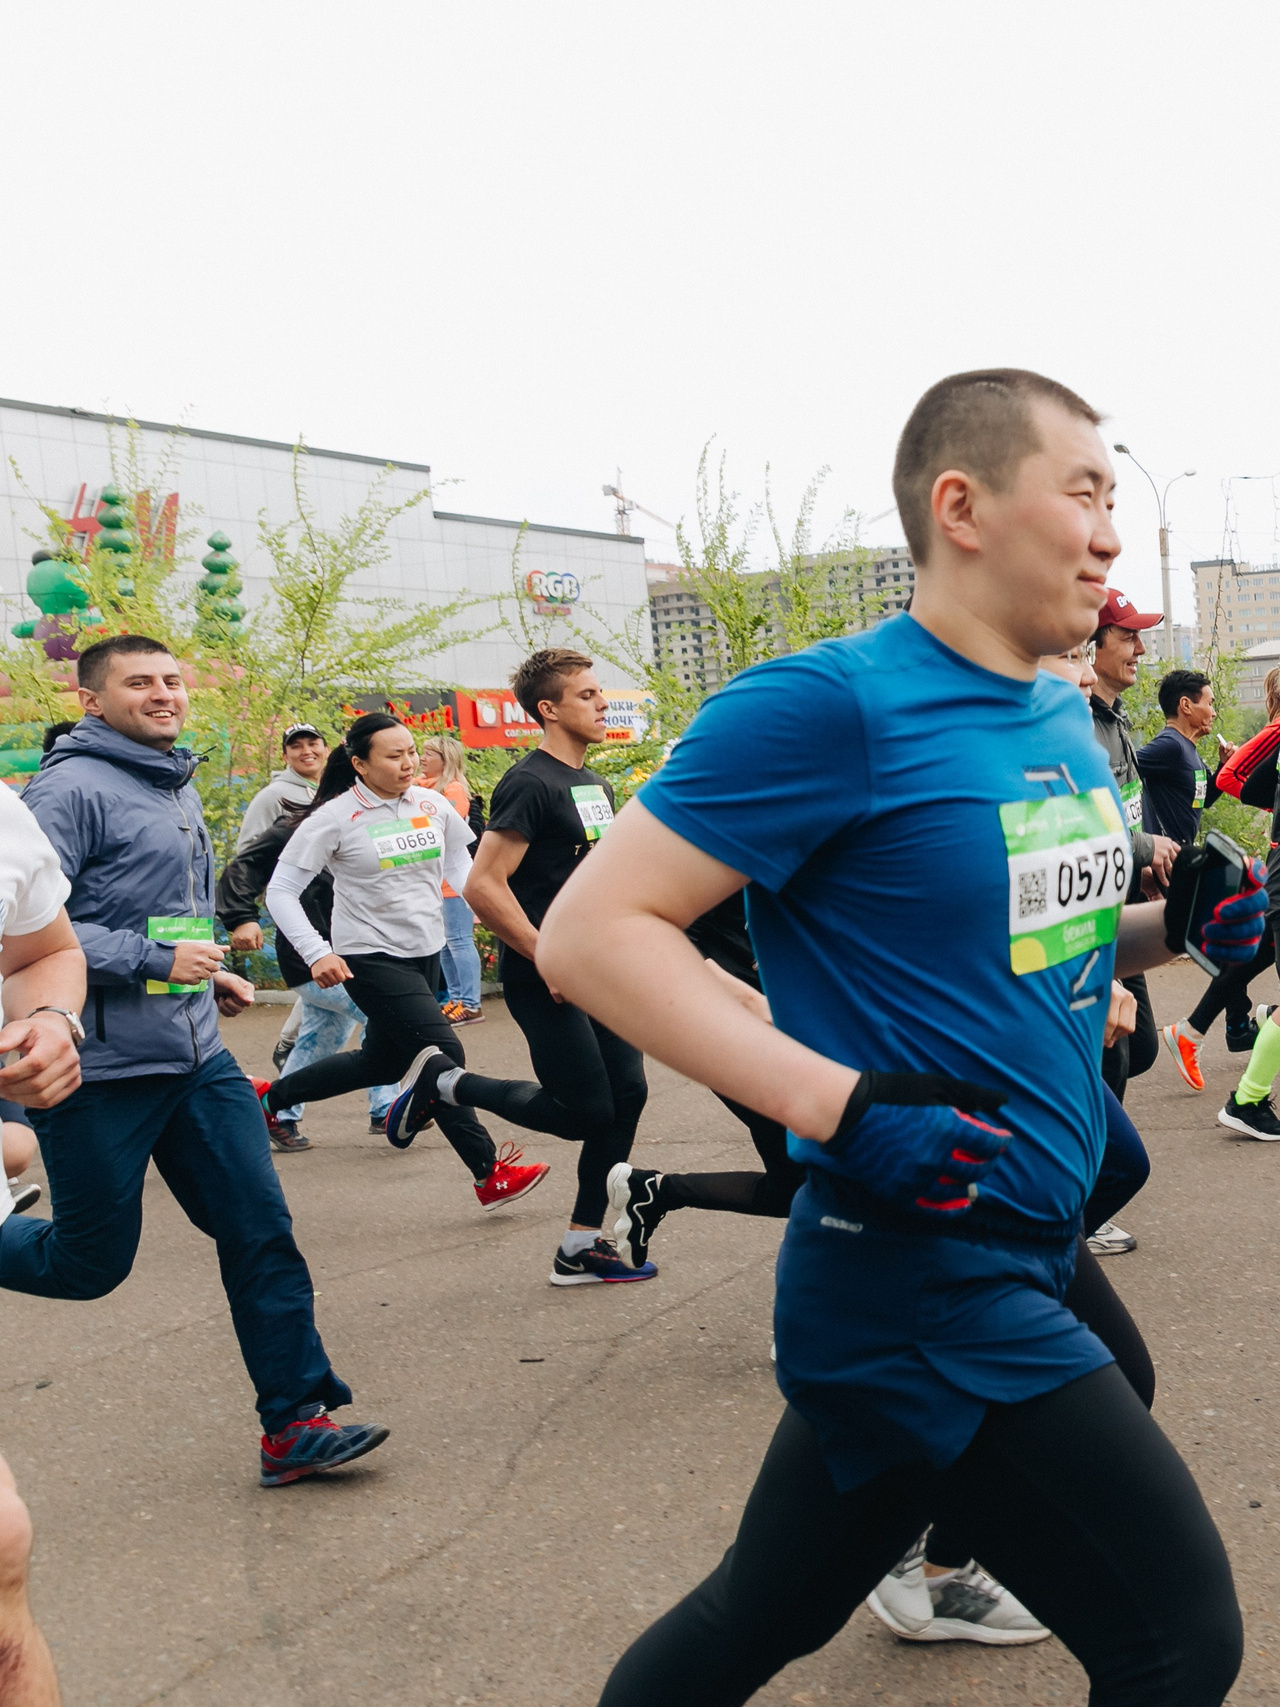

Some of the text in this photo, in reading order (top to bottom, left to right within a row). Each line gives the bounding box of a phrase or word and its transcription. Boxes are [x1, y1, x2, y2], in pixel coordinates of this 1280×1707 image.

[526, 571, 580, 602] RGB
[396, 831, 436, 850] 0669
[1058, 847, 1126, 907] 0578
